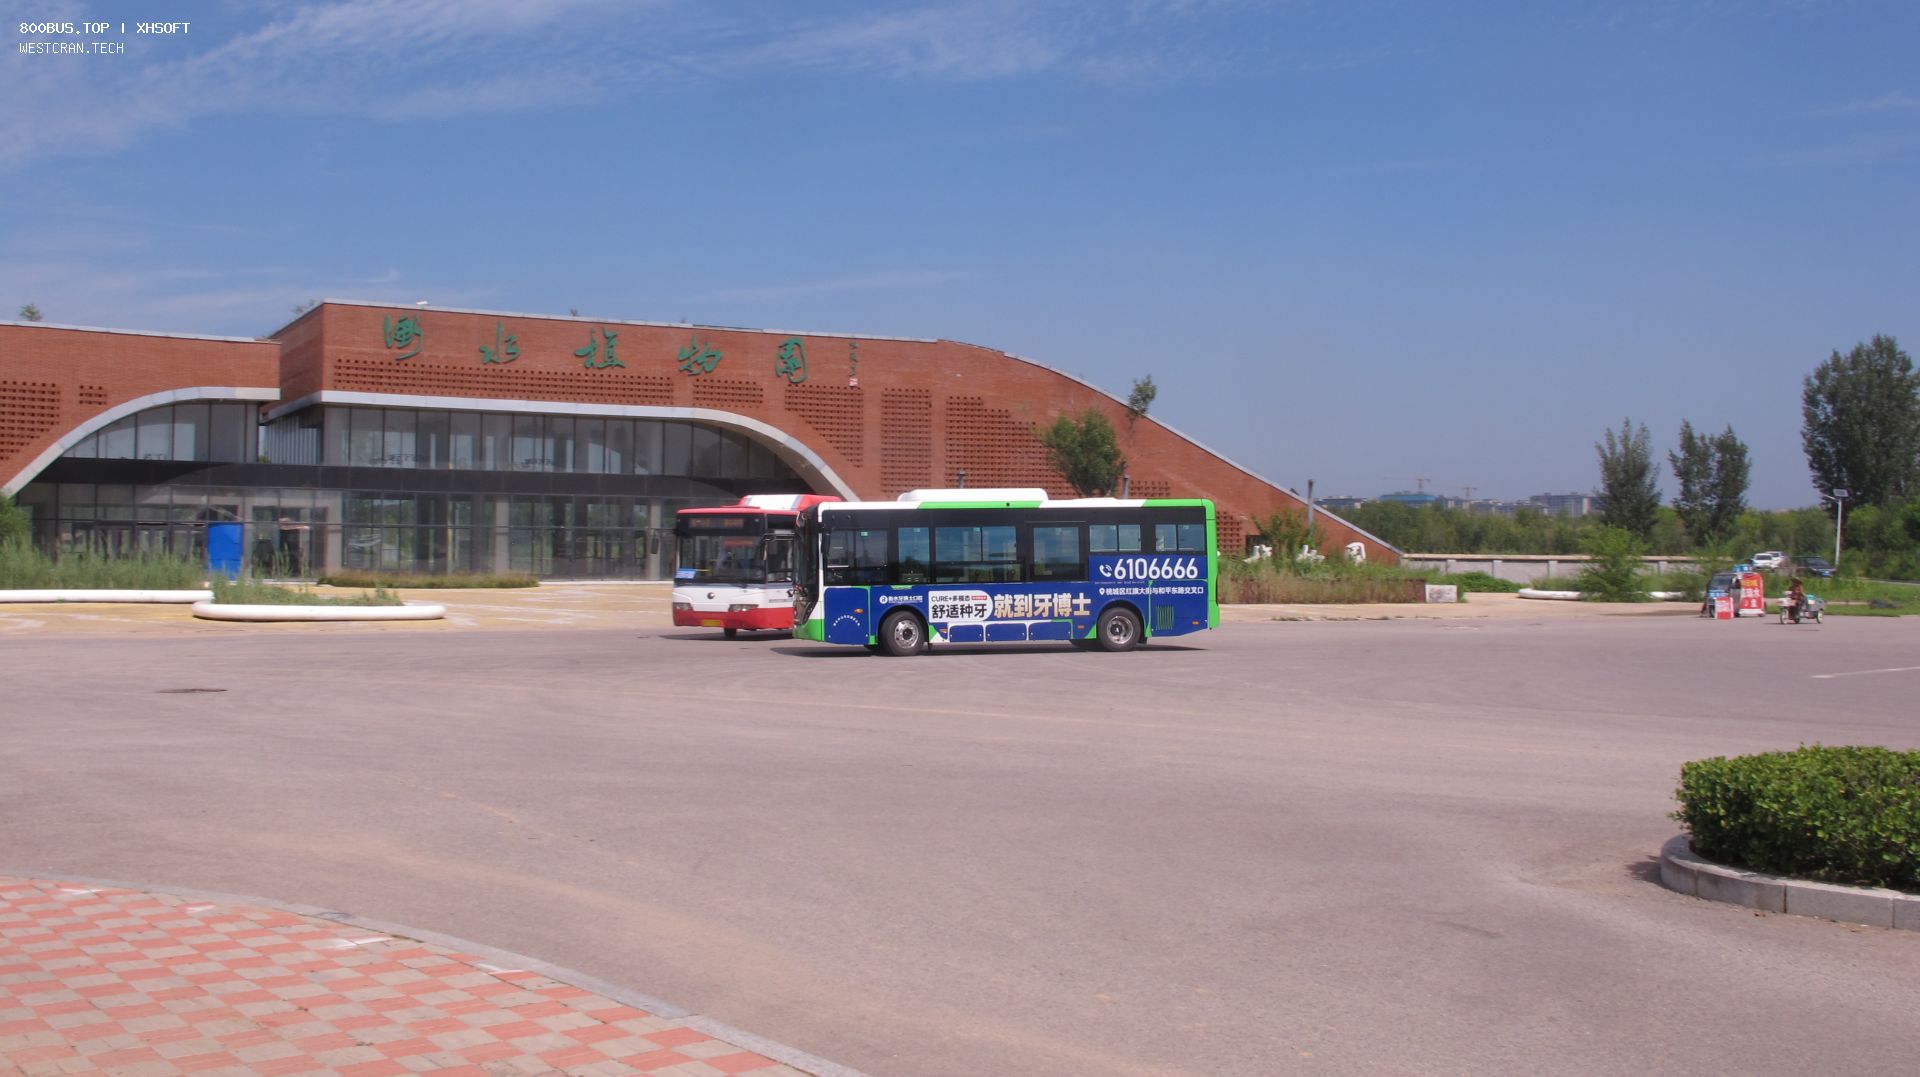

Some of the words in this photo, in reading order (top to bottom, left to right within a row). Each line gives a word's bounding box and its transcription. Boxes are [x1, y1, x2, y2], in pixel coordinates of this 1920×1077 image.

[1114, 557, 1198, 580] 6106666
[931, 603, 988, 619] 舒适种牙
[993, 592, 1092, 618] 就到牙博士
